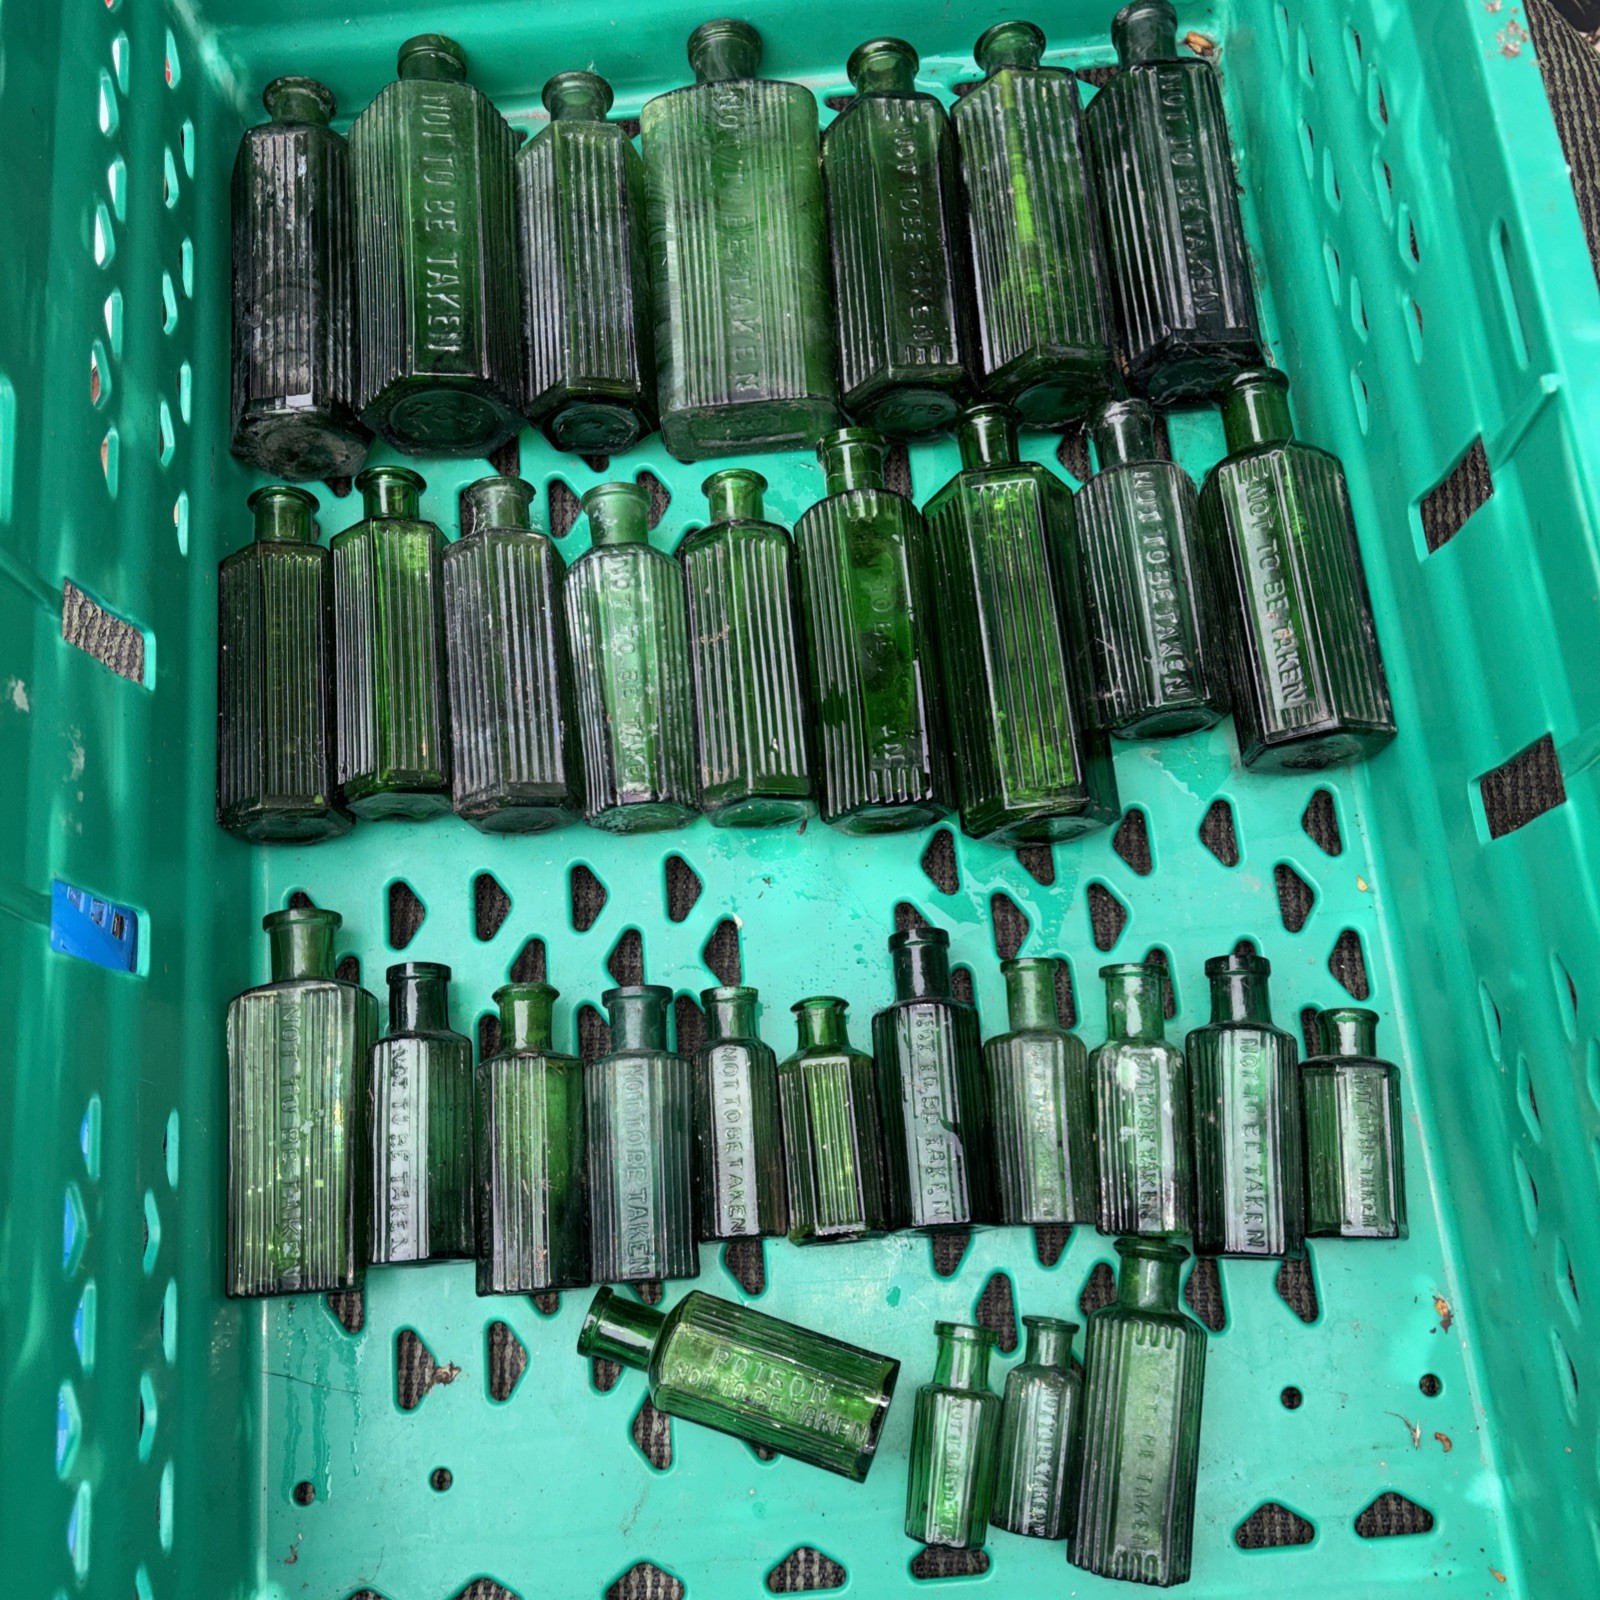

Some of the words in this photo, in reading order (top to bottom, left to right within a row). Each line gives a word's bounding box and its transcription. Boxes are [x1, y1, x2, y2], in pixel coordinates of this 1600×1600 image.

[421, 93, 452, 141] NOT
[1158, 70, 1191, 125] NOT
[423, 155, 454, 186] TO
[1168, 132, 1197, 168] TO
[424, 199, 459, 232] BE
[1175, 176, 1208, 214] BE
[1182, 217, 1226, 315] TAKEN
[427, 251, 462, 352] TAKEN
[728, 268, 761, 395] TAKEN
[1132, 471, 1162, 522] NOT
[1247, 483, 1275, 531] NOT
[1142, 529, 1170, 564] TO
[1257, 538, 1281, 574] TO
[608, 556, 635, 607] NOT
[1148, 568, 1175, 604] BE
[1264, 578, 1290, 618] BE
[1154, 606, 1191, 696] TAKEN
[1272, 619, 1309, 704] TAKEN
[620, 668, 644, 701] BE
[281, 1004, 301, 1057] NOT
[916, 1011, 936, 1053] NOT
[390, 1046, 409, 1091] NOT
[721, 1045, 741, 1090] NOT
[918, 1061, 940, 1093] TO
[1240, 1037, 1260, 1081] NOT
[281, 1078, 301, 1114] TO
[623, 1063, 646, 1108] NOT
[1242, 1084, 1259, 1116] TO
[391, 1100, 410, 1126] TO
[626, 1113, 646, 1145] TO
[723, 1095, 742, 1124] TO
[921, 1094, 942, 1127] BE
[389, 1133, 409, 1162] BE
[725, 1126, 744, 1154] BE
[1242, 1122, 1262, 1155] BE
[626, 1150, 649, 1184] BE
[926, 1134, 951, 1217] TAKEN
[1138, 1149, 1161, 1222] TAKEN
[389, 1170, 411, 1258] TAKEN
[727, 1157, 748, 1233] TAKEN
[1243, 1163, 1267, 1248] TAKEN
[1360, 1166, 1380, 1227] TAKEN
[627, 1187, 651, 1279] TAKEN
[712, 1346, 832, 1407] POISON
[674, 1358, 712, 1387] NOT
[720, 1376, 748, 1401] TO
[753, 1387, 784, 1414] BE
[788, 1399, 868, 1443] TAKEN
[1129, 1473, 1154, 1550] TAKEN
